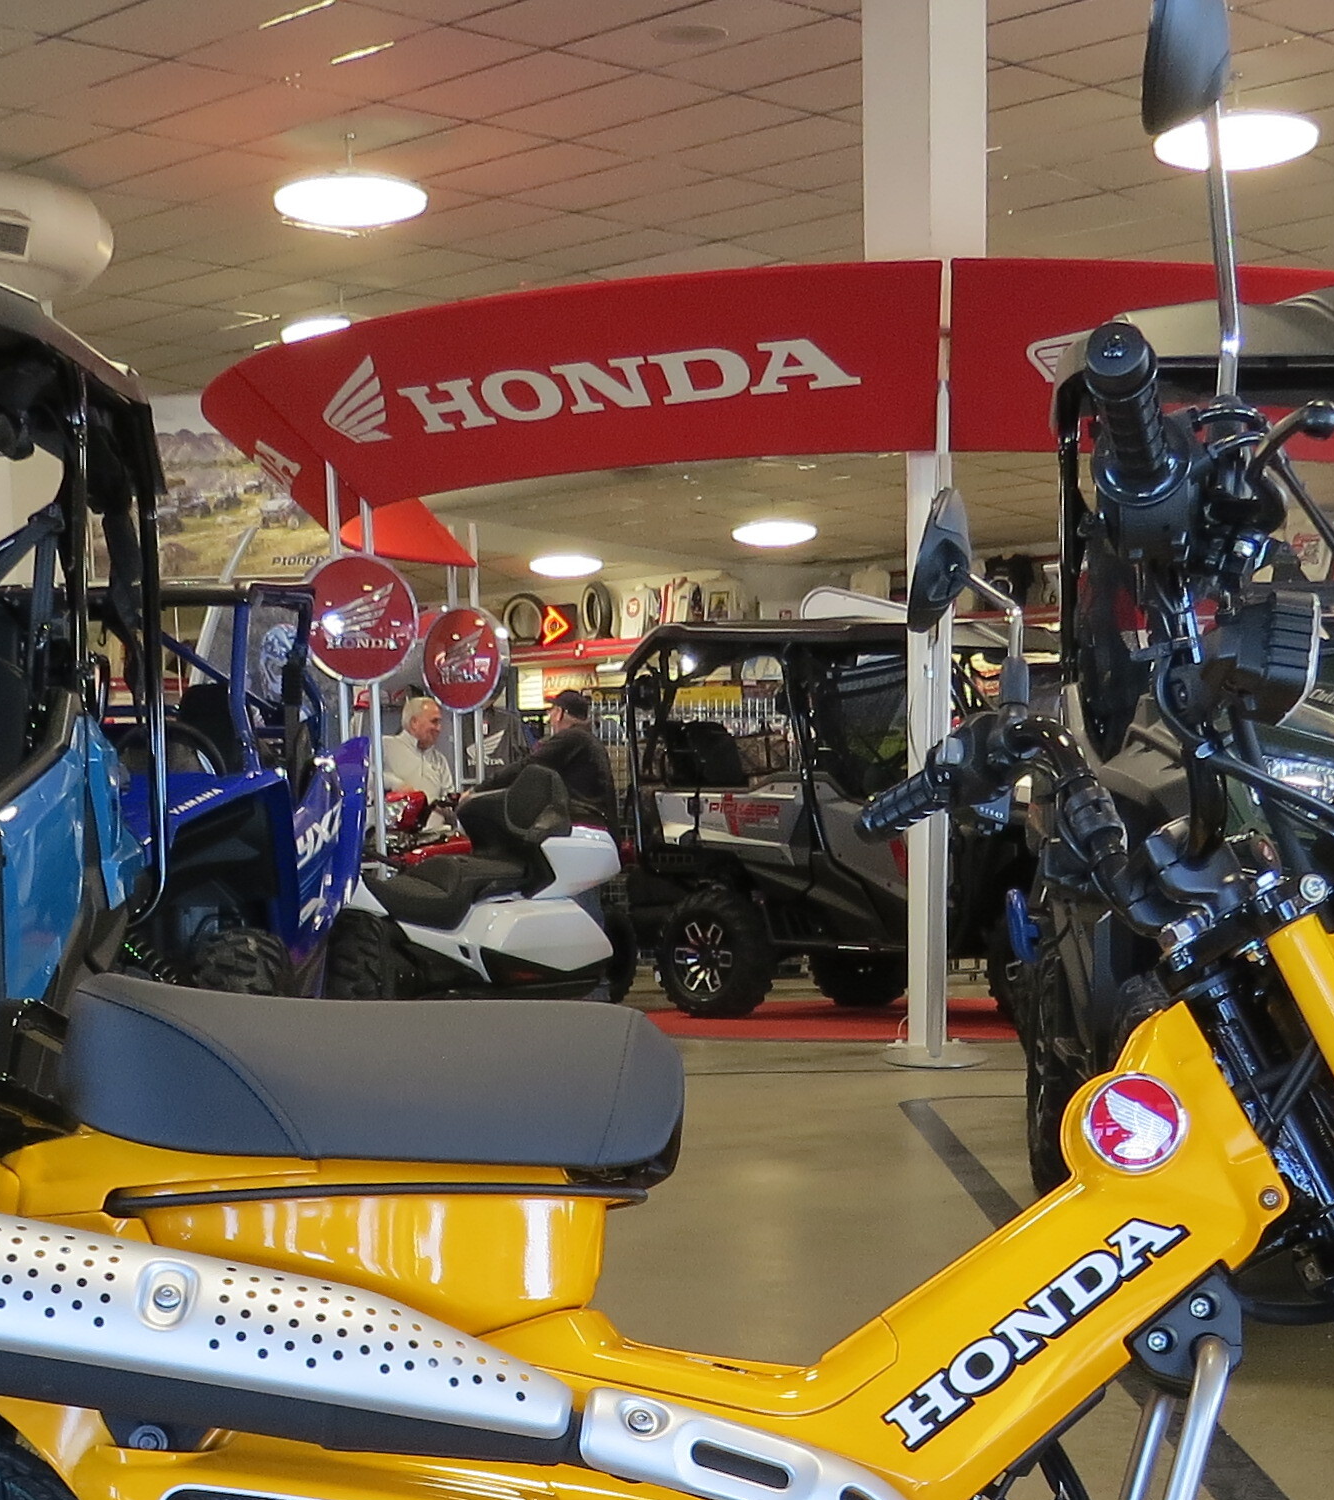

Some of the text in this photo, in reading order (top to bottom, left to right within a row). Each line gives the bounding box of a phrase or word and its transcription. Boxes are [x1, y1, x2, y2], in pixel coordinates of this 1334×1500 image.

[397, 337, 861, 435] HONDA
[326, 637, 398, 651] HONDA
[467, 756, 506, 767] HNDA
[168, 787, 225, 816] YAMAHA
[881, 1218, 1191, 1452] HONDA
